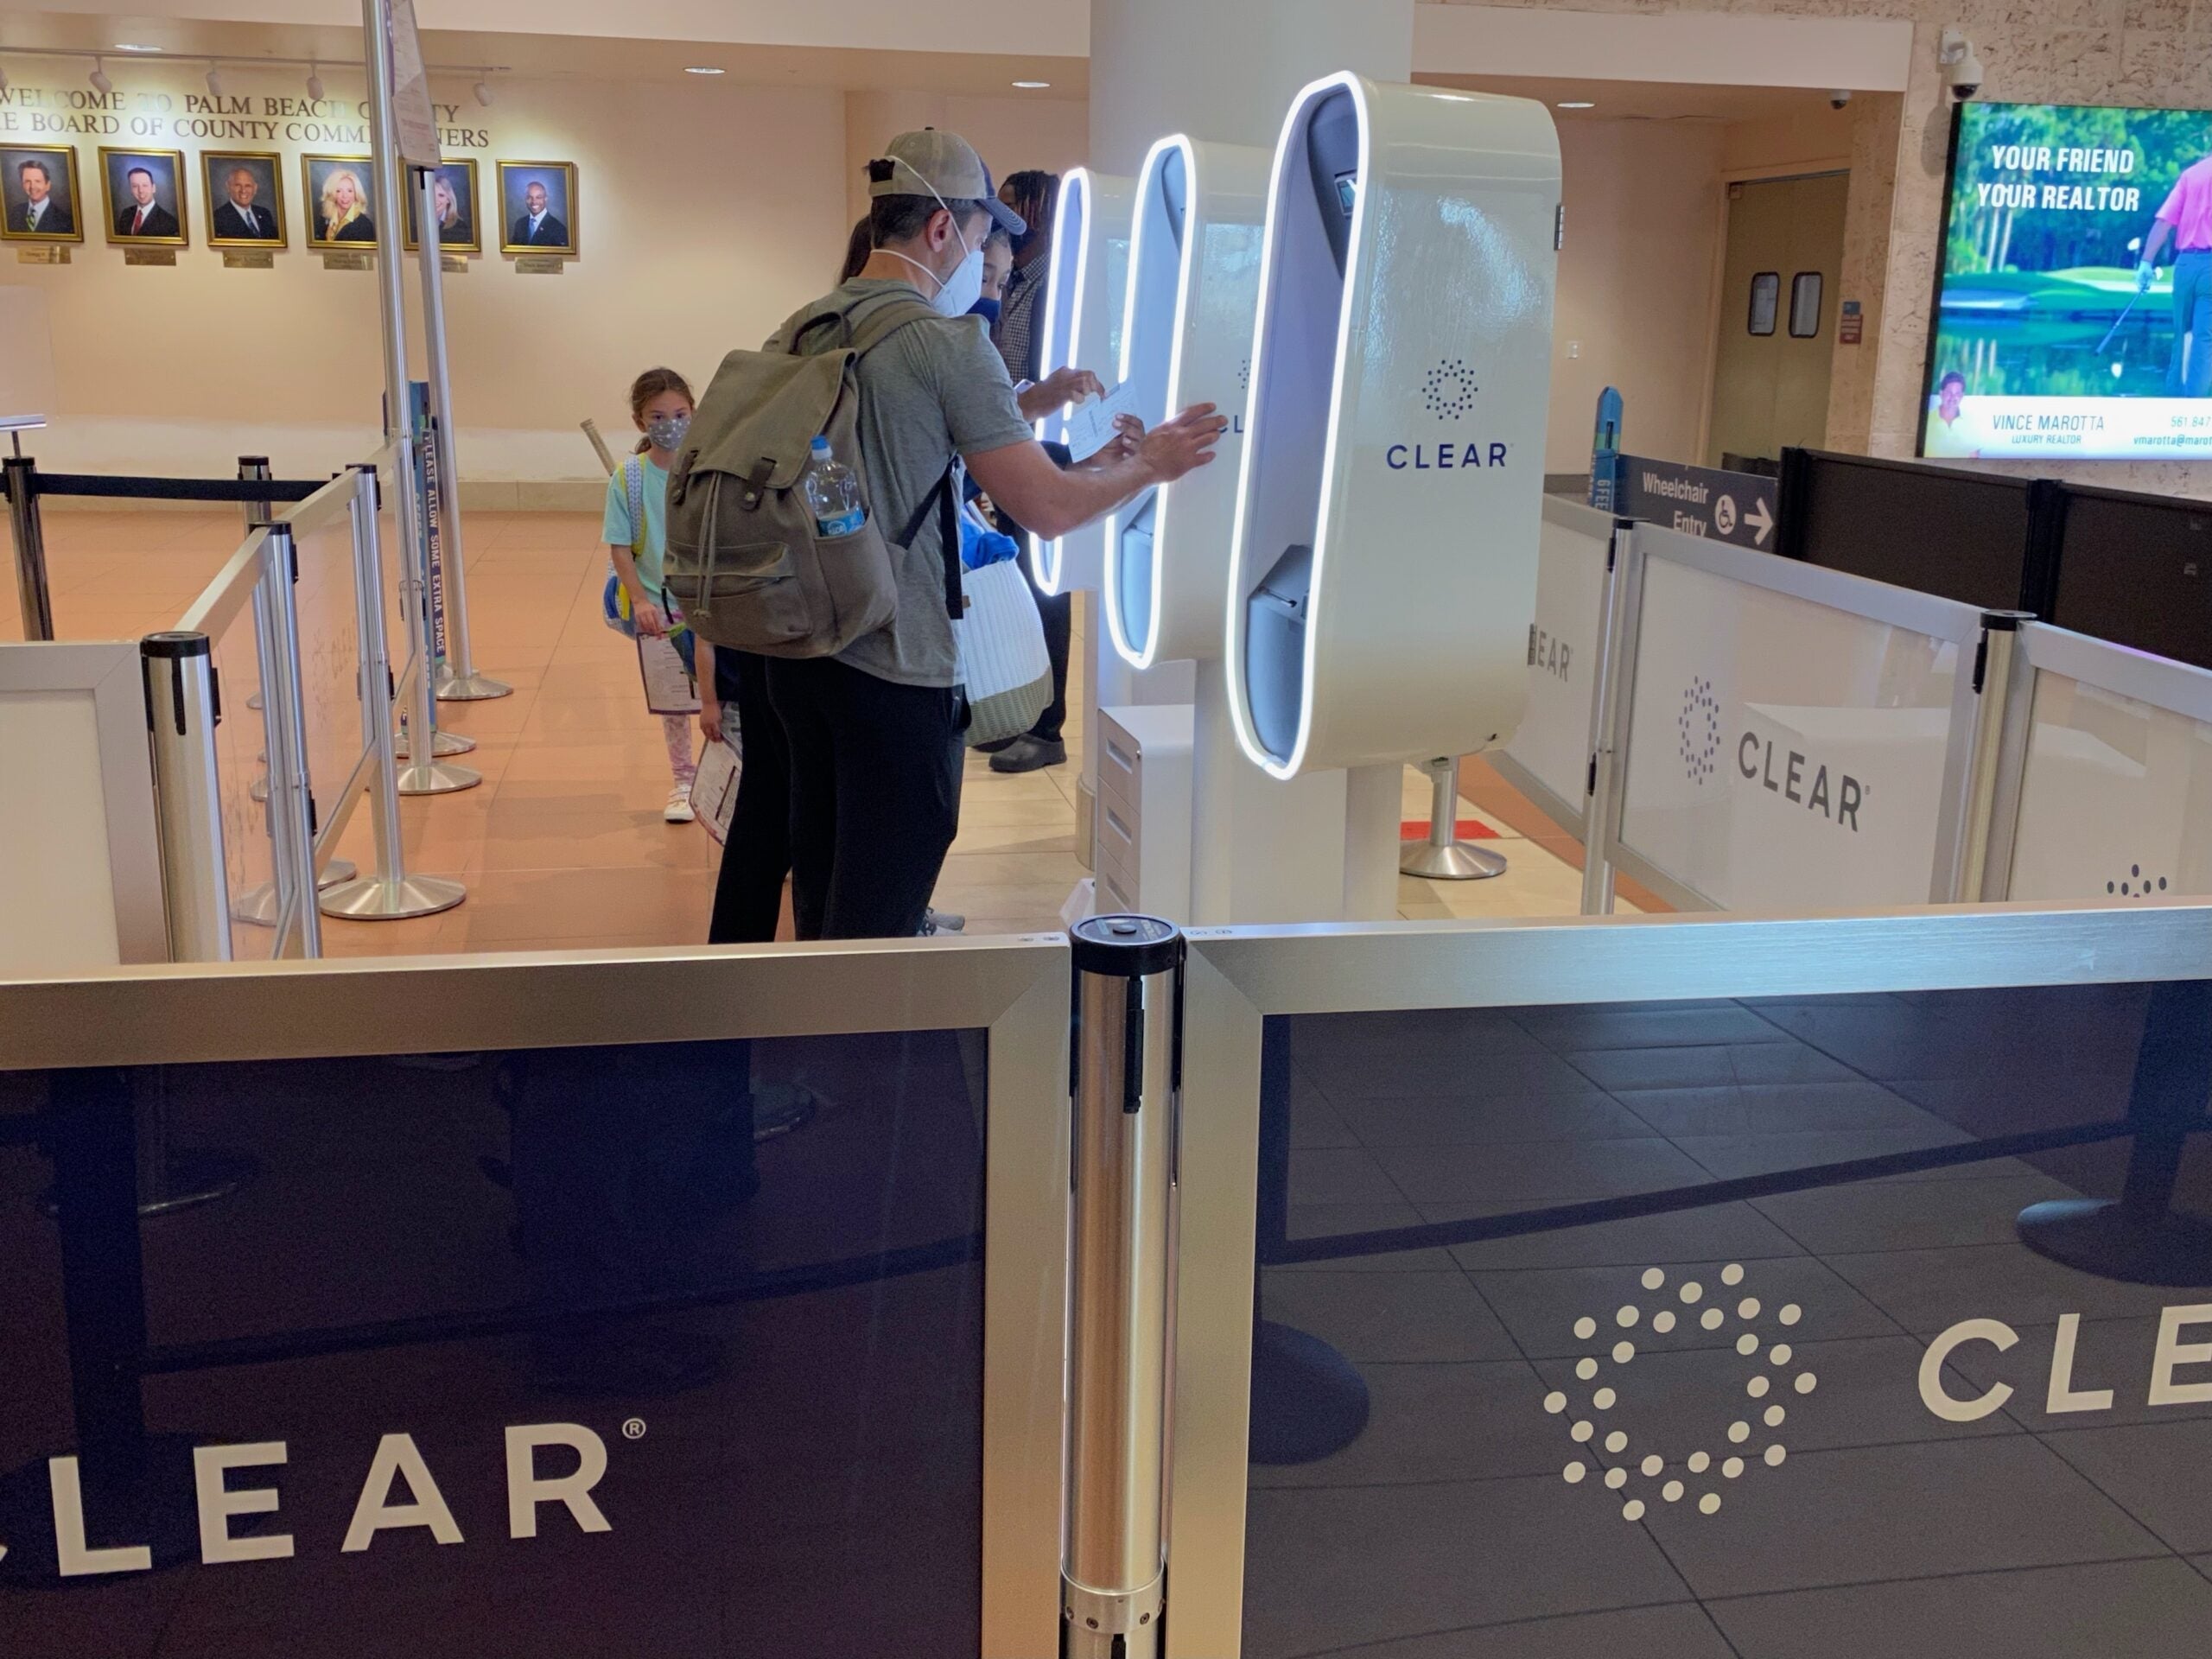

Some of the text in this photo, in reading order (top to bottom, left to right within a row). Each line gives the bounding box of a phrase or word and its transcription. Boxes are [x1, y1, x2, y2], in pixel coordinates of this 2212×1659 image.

[137, 92, 172, 112] TO
[184, 93, 253, 115] PALM
[264, 97, 348, 119] BEACH
[31, 112, 120, 135] BOARD
[130, 117, 164, 137] OF
[173, 118, 278, 141] COUNTY
[1992, 145, 2134, 174] YOUR FRIEND
[1977, 183, 2140, 212] YOUR REALTOR
[1993, 415, 2105, 431] VINCE MAROTTA
[2012, 435, 2082, 444] LUXURY REALTOR
[1386, 442, 1507, 469] CLEAR
[1643, 472, 1709, 504] Wheelchair
[428, 489, 438, 528] ALLOW
[1674, 510, 1707, 537] Entry
[430, 535, 441, 569] SOME
[433, 574, 442, 612] EXTRA
[435, 616, 445, 653] SPACE
